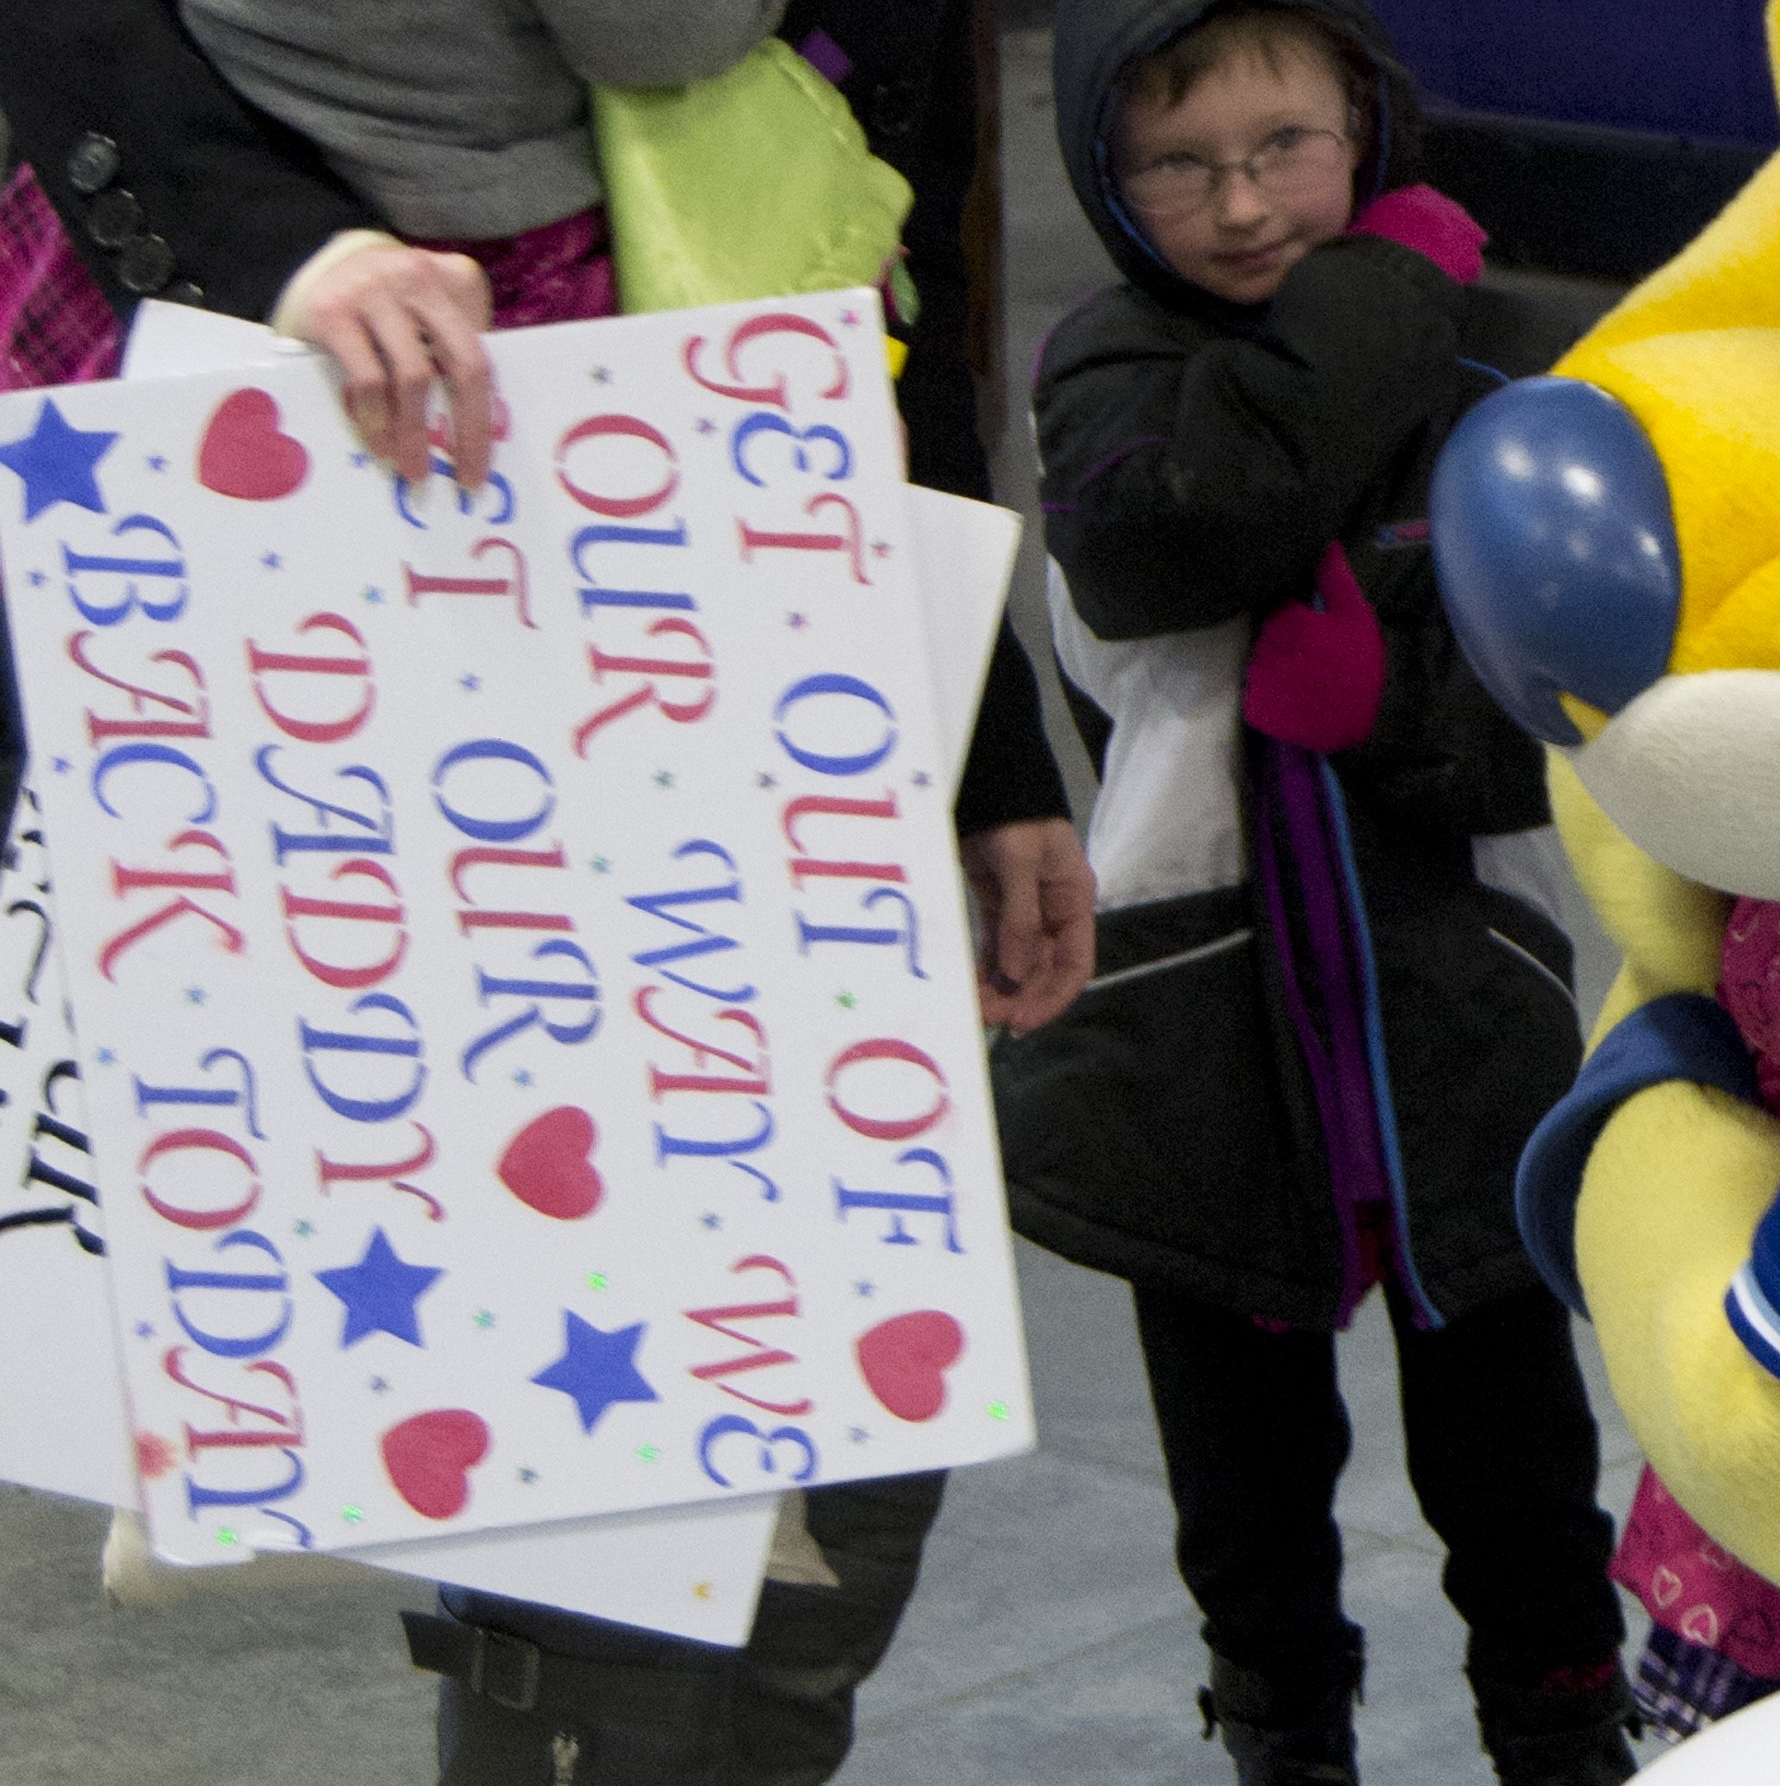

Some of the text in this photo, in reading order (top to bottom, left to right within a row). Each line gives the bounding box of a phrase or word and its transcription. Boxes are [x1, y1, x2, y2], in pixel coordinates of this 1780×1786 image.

[61, 513, 316, 1549] BACK TODAY
[246, 611, 448, 1222] DADDY
[393, 397, 600, 1085] ET OUR
[557, 413, 822, 1490] OUR WAY WE
[685, 311, 966, 1255] GET OUT OF
